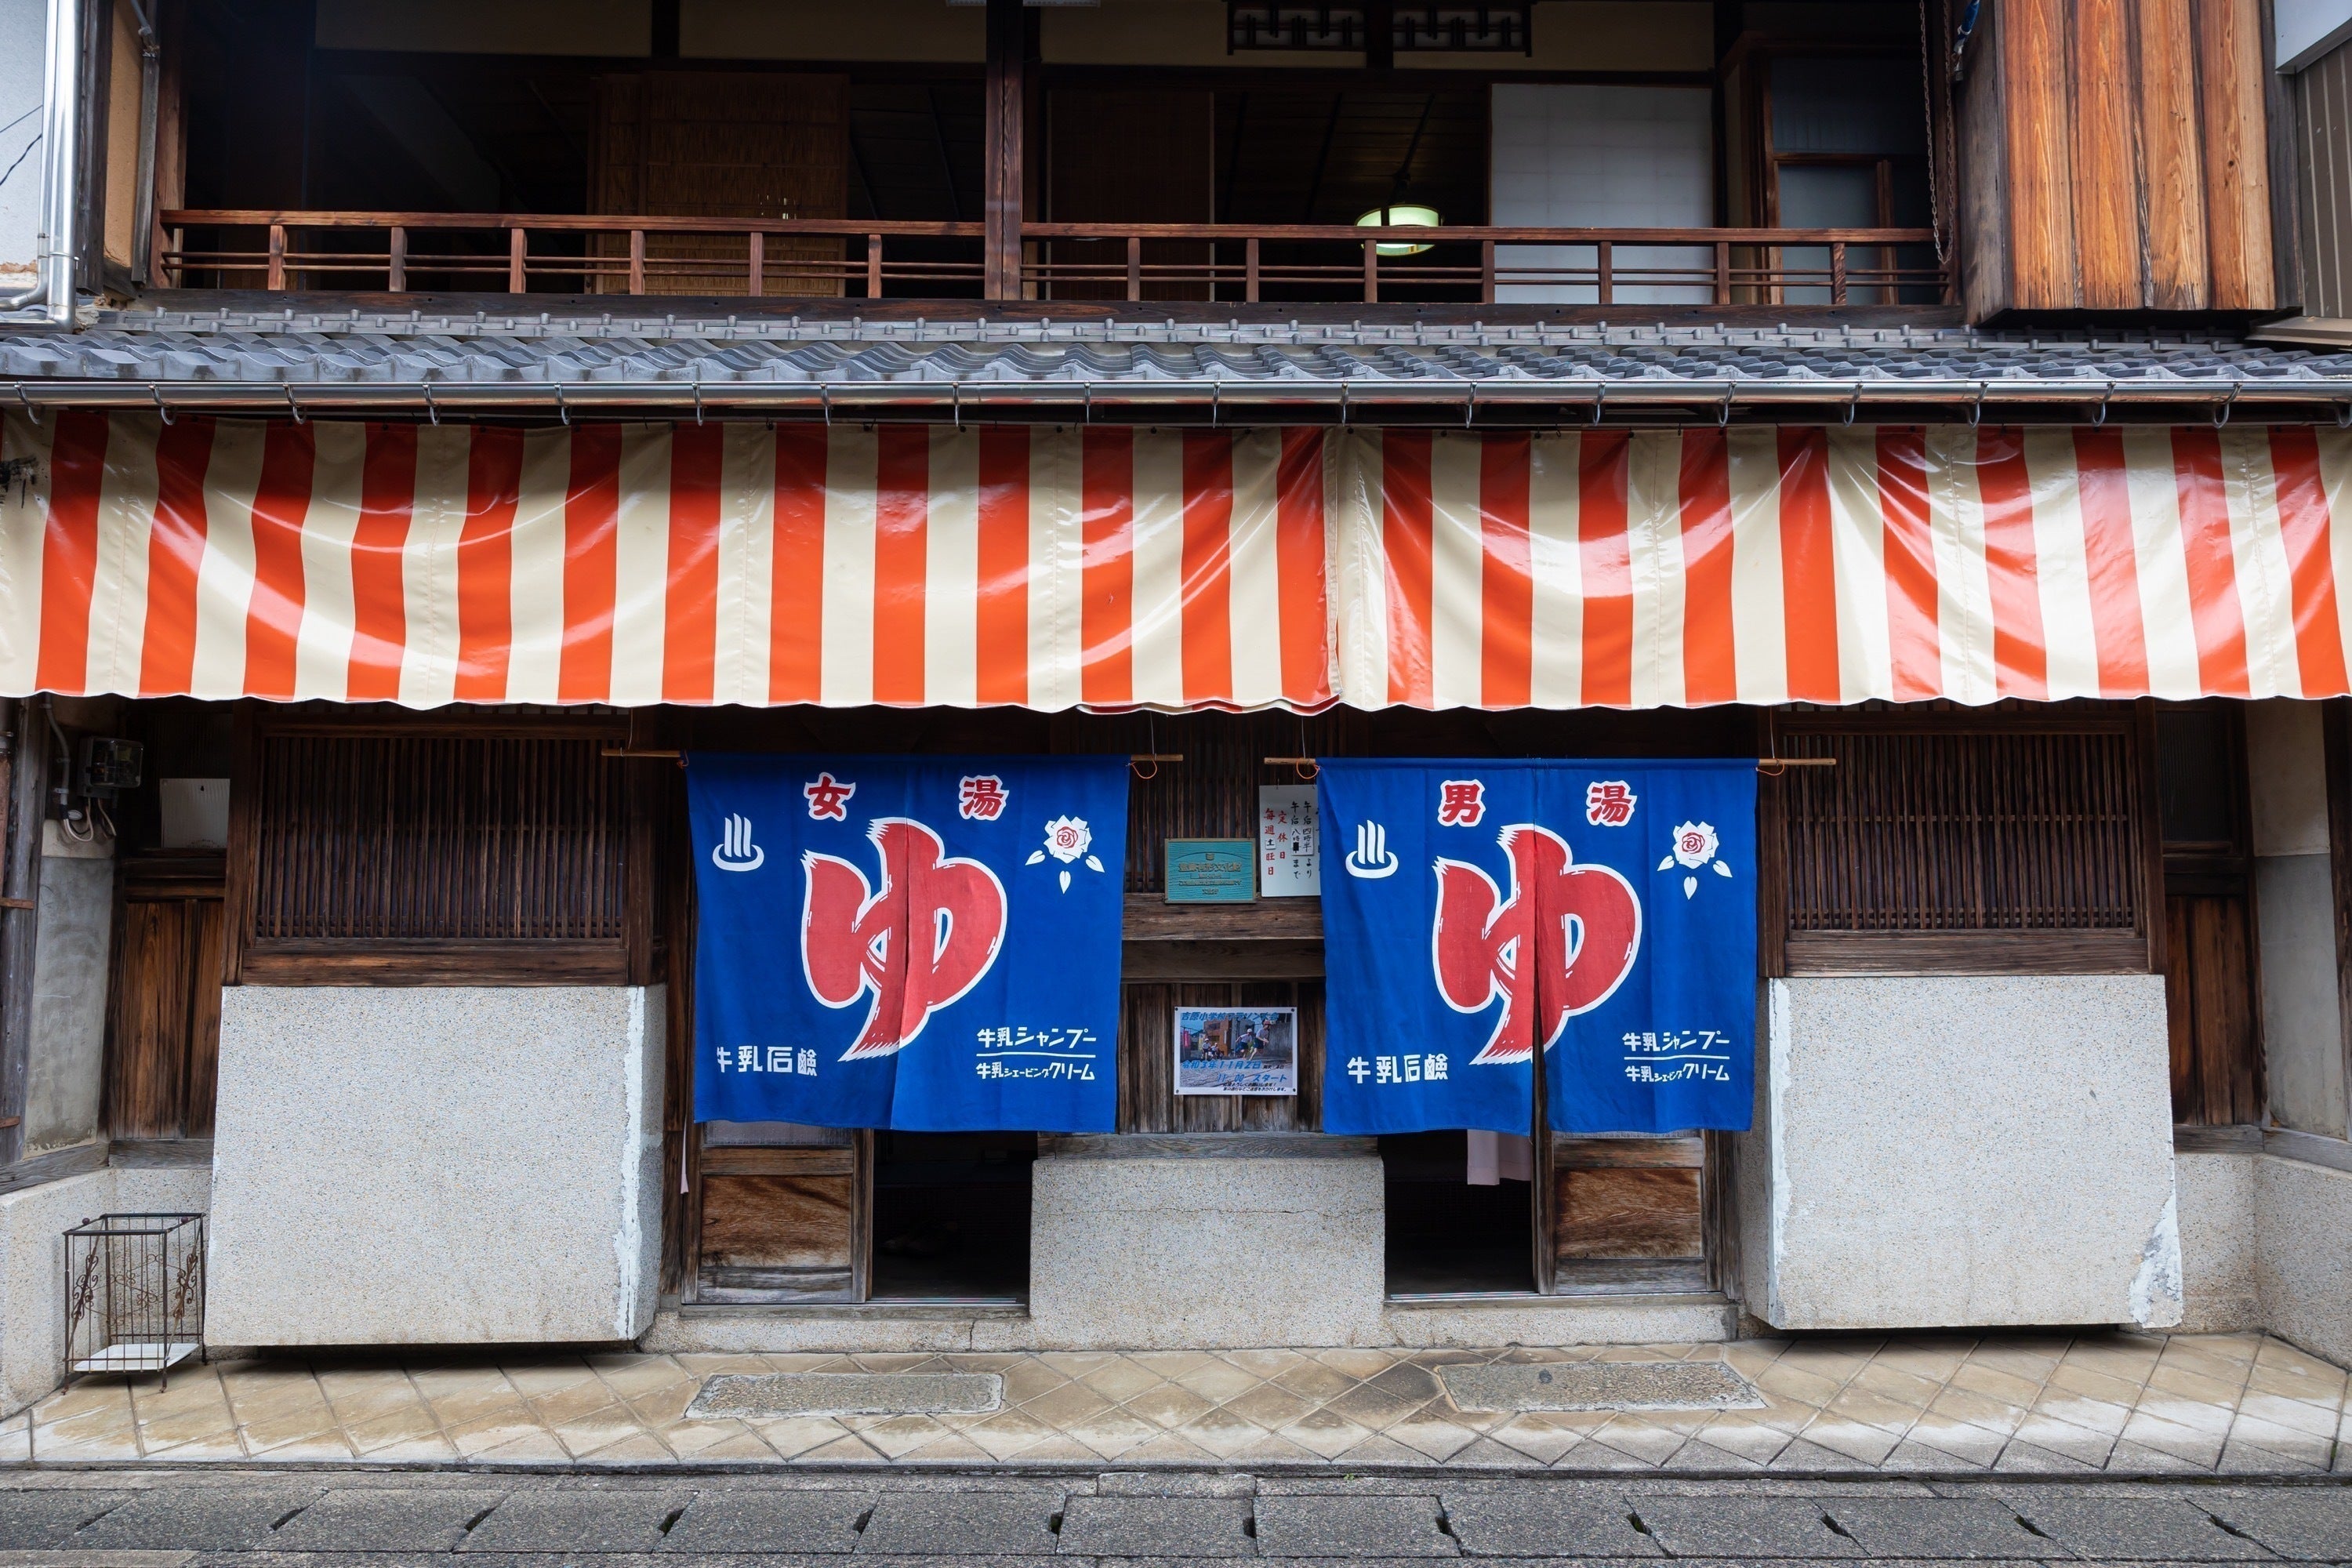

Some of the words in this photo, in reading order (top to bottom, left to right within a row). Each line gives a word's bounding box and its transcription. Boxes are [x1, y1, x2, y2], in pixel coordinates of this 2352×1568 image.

[1277, 810, 1287, 859] 定休日
[801, 817, 1007, 1062] ゆ
[1432, 824, 1642, 1065] ゆ
[977, 1027, 1097, 1049] 牛乳シャンプー
[1622, 1030, 1730, 1051] 牛乳シャンプー
[975, 1062, 1095, 1080] 牛乳シェービングクリーム
